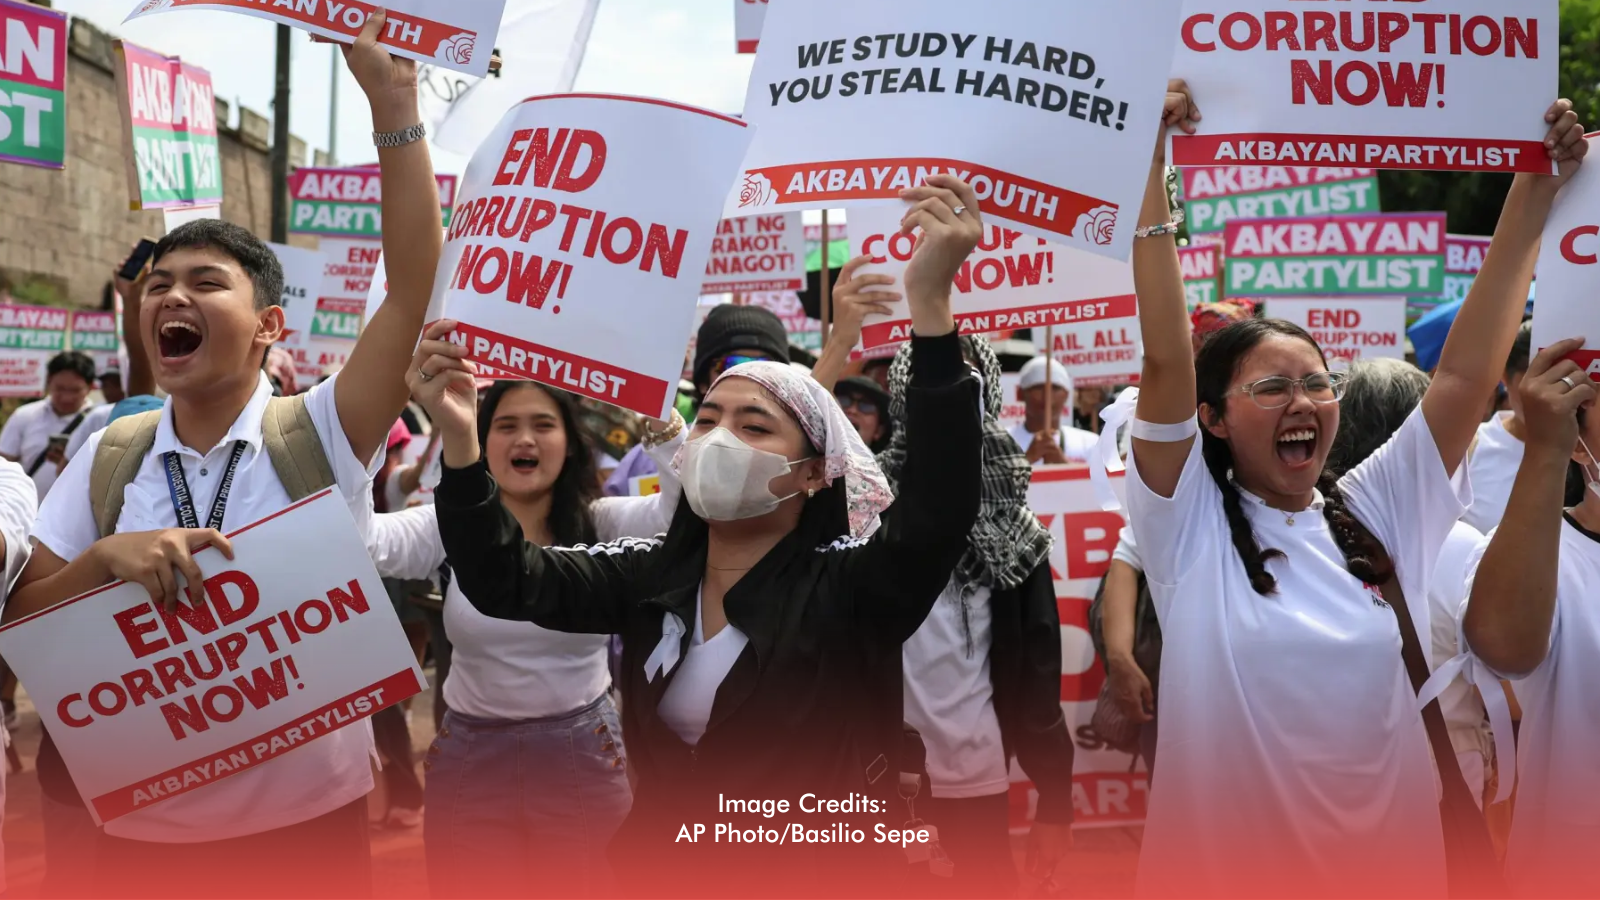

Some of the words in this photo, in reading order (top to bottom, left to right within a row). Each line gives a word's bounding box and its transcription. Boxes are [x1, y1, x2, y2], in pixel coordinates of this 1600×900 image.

[325, 0, 424, 45] YOTH
[1181, 11, 1538, 58] CORRUPTION
[797, 38, 845, 69] WE
[851, 32, 977, 58] STUDY
[983, 37, 1106, 89] HARD,
[1290, 59, 1446, 108] NOW!
[768, 73, 832, 107] YOU
[838, 67, 946, 97] STEAL
[954, 69, 1130, 131] HARDER!
[493, 127, 607, 193] END
[1214, 141, 1357, 163] AKBAYAN
[1365, 144, 1520, 167] PARTYLIST
[785, 165, 940, 194] AKBAYAN
[756, 215, 786, 232] NG
[1191, 182, 1371, 229] PARTYLIST
[448, 195, 689, 279] CORRUPTION
[1232, 221, 1439, 254] AKBAYAN
[450, 245, 574, 315] NOW!
[1232, 259, 1437, 289] PARTYLIST
[996, 303, 1110, 328] PARTYLIST
[1094, 327, 1134, 348] ALL
[1307, 309, 1361, 328] END
[473, 335, 627, 400] PARTYLIST
[167, 455, 189, 505] PROVIDENTIAL
[212, 499, 227, 517] CITY
[56, 578, 371, 728] CORRUPTION
[160, 654, 306, 741] NOW!
[132, 750, 249, 806] AKBAYAN
[252, 687, 386, 761] PARTYLIST
